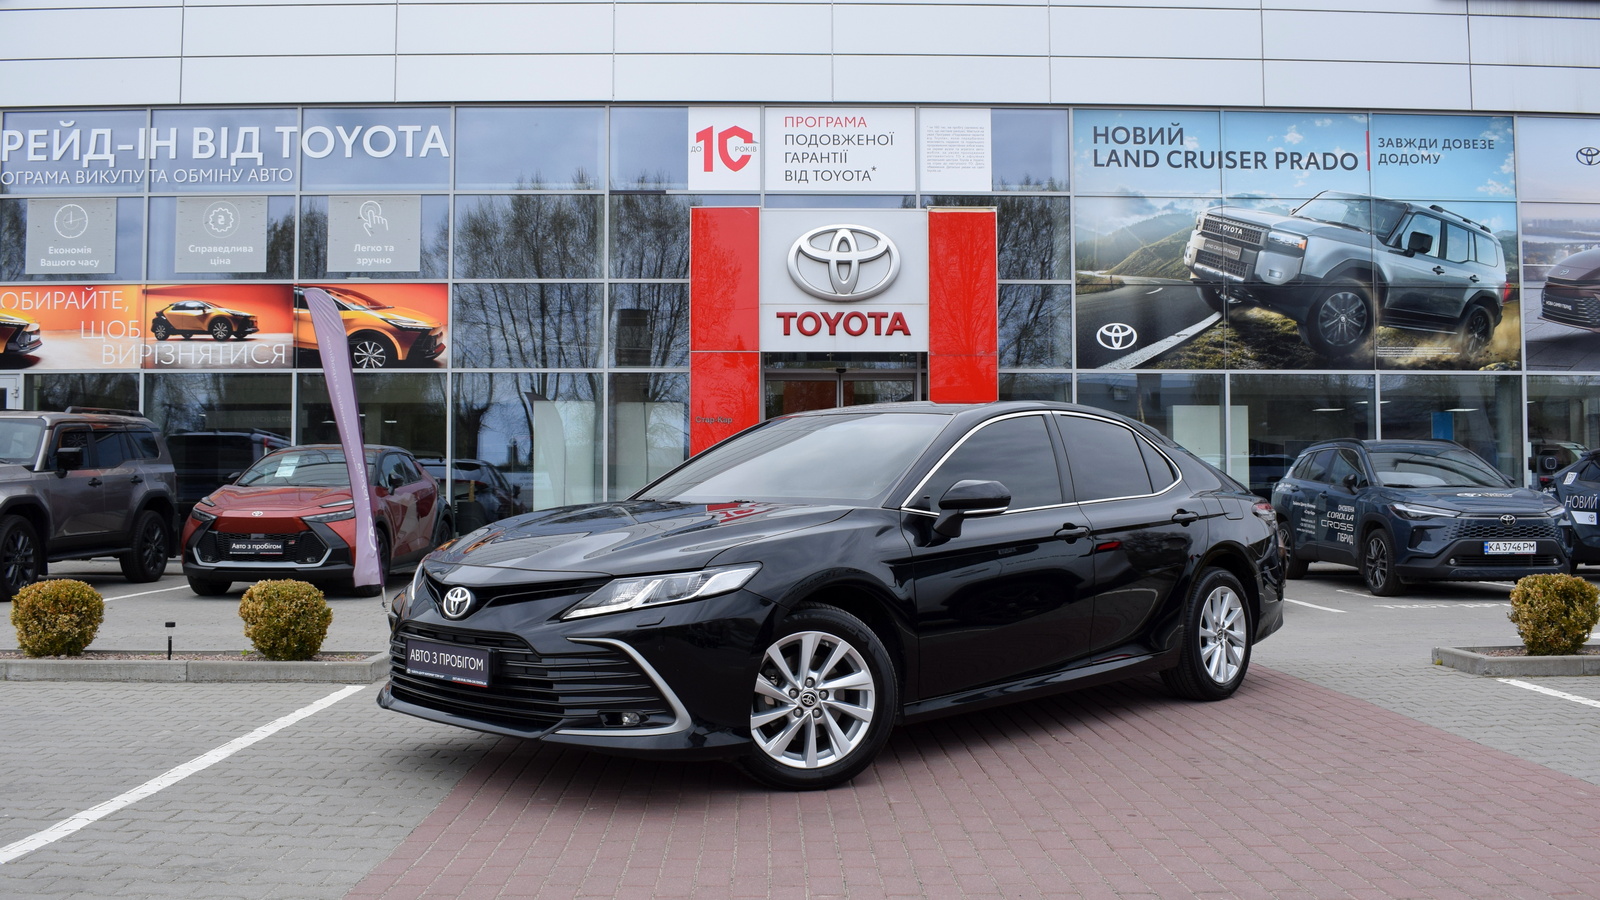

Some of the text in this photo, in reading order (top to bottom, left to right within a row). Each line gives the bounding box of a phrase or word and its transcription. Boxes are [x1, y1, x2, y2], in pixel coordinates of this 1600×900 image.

[784, 116, 868, 128] ПРОГРАМА
[784, 131, 894, 147] ПОДОВЖЕНОЇ
[1093, 122, 1184, 145] НОВИЙ
[192, 126, 264, 166] ВІД
[275, 125, 450, 159] TOYOTA
[1378, 137, 1495, 151] ЗАВЖДИ ДОВЕЗЕ
[784, 150, 848, 164] ГАРАНТІЇ
[1093, 149, 1359, 171] LAND CRUISER PRADO
[1378, 153, 1441, 166] ДОДОМУ
[75, 169, 146, 184] ВИКУПУ
[149, 168, 168, 182] ТА
[173, 168, 244, 182] ОБМІНУ
[247, 167, 293, 182] АВТО
[784, 170, 809, 183] ВІД
[1219, 223, 1243, 235] TOYOTA
[48, 246, 92, 255] Економія
[188, 244, 254, 254] Справедлива
[353, 244, 382, 252] Легко
[40, 258, 99, 268] Вашого часу
[210, 256, 231, 266] ціна
[356, 257, 392, 266] зручно
[776, 311, 911, 336] TOYOTA
[81, 320, 140, 342] ЩОБ
[102, 343, 286, 365] ВИРІЗНЯТИСЯ
[696, 416, 733, 424] Стар-Кар
[1564, 493, 1598, 509] НОВИЙ
[1326, 511, 1354, 521] COROLLA
[1320, 519, 1354, 532] CROSS
[1488, 542, 1535, 551] KA 3746 PM
[410, 648, 431, 663] АВТО
[439, 653, 484, 671] ПРОБІГОМ
